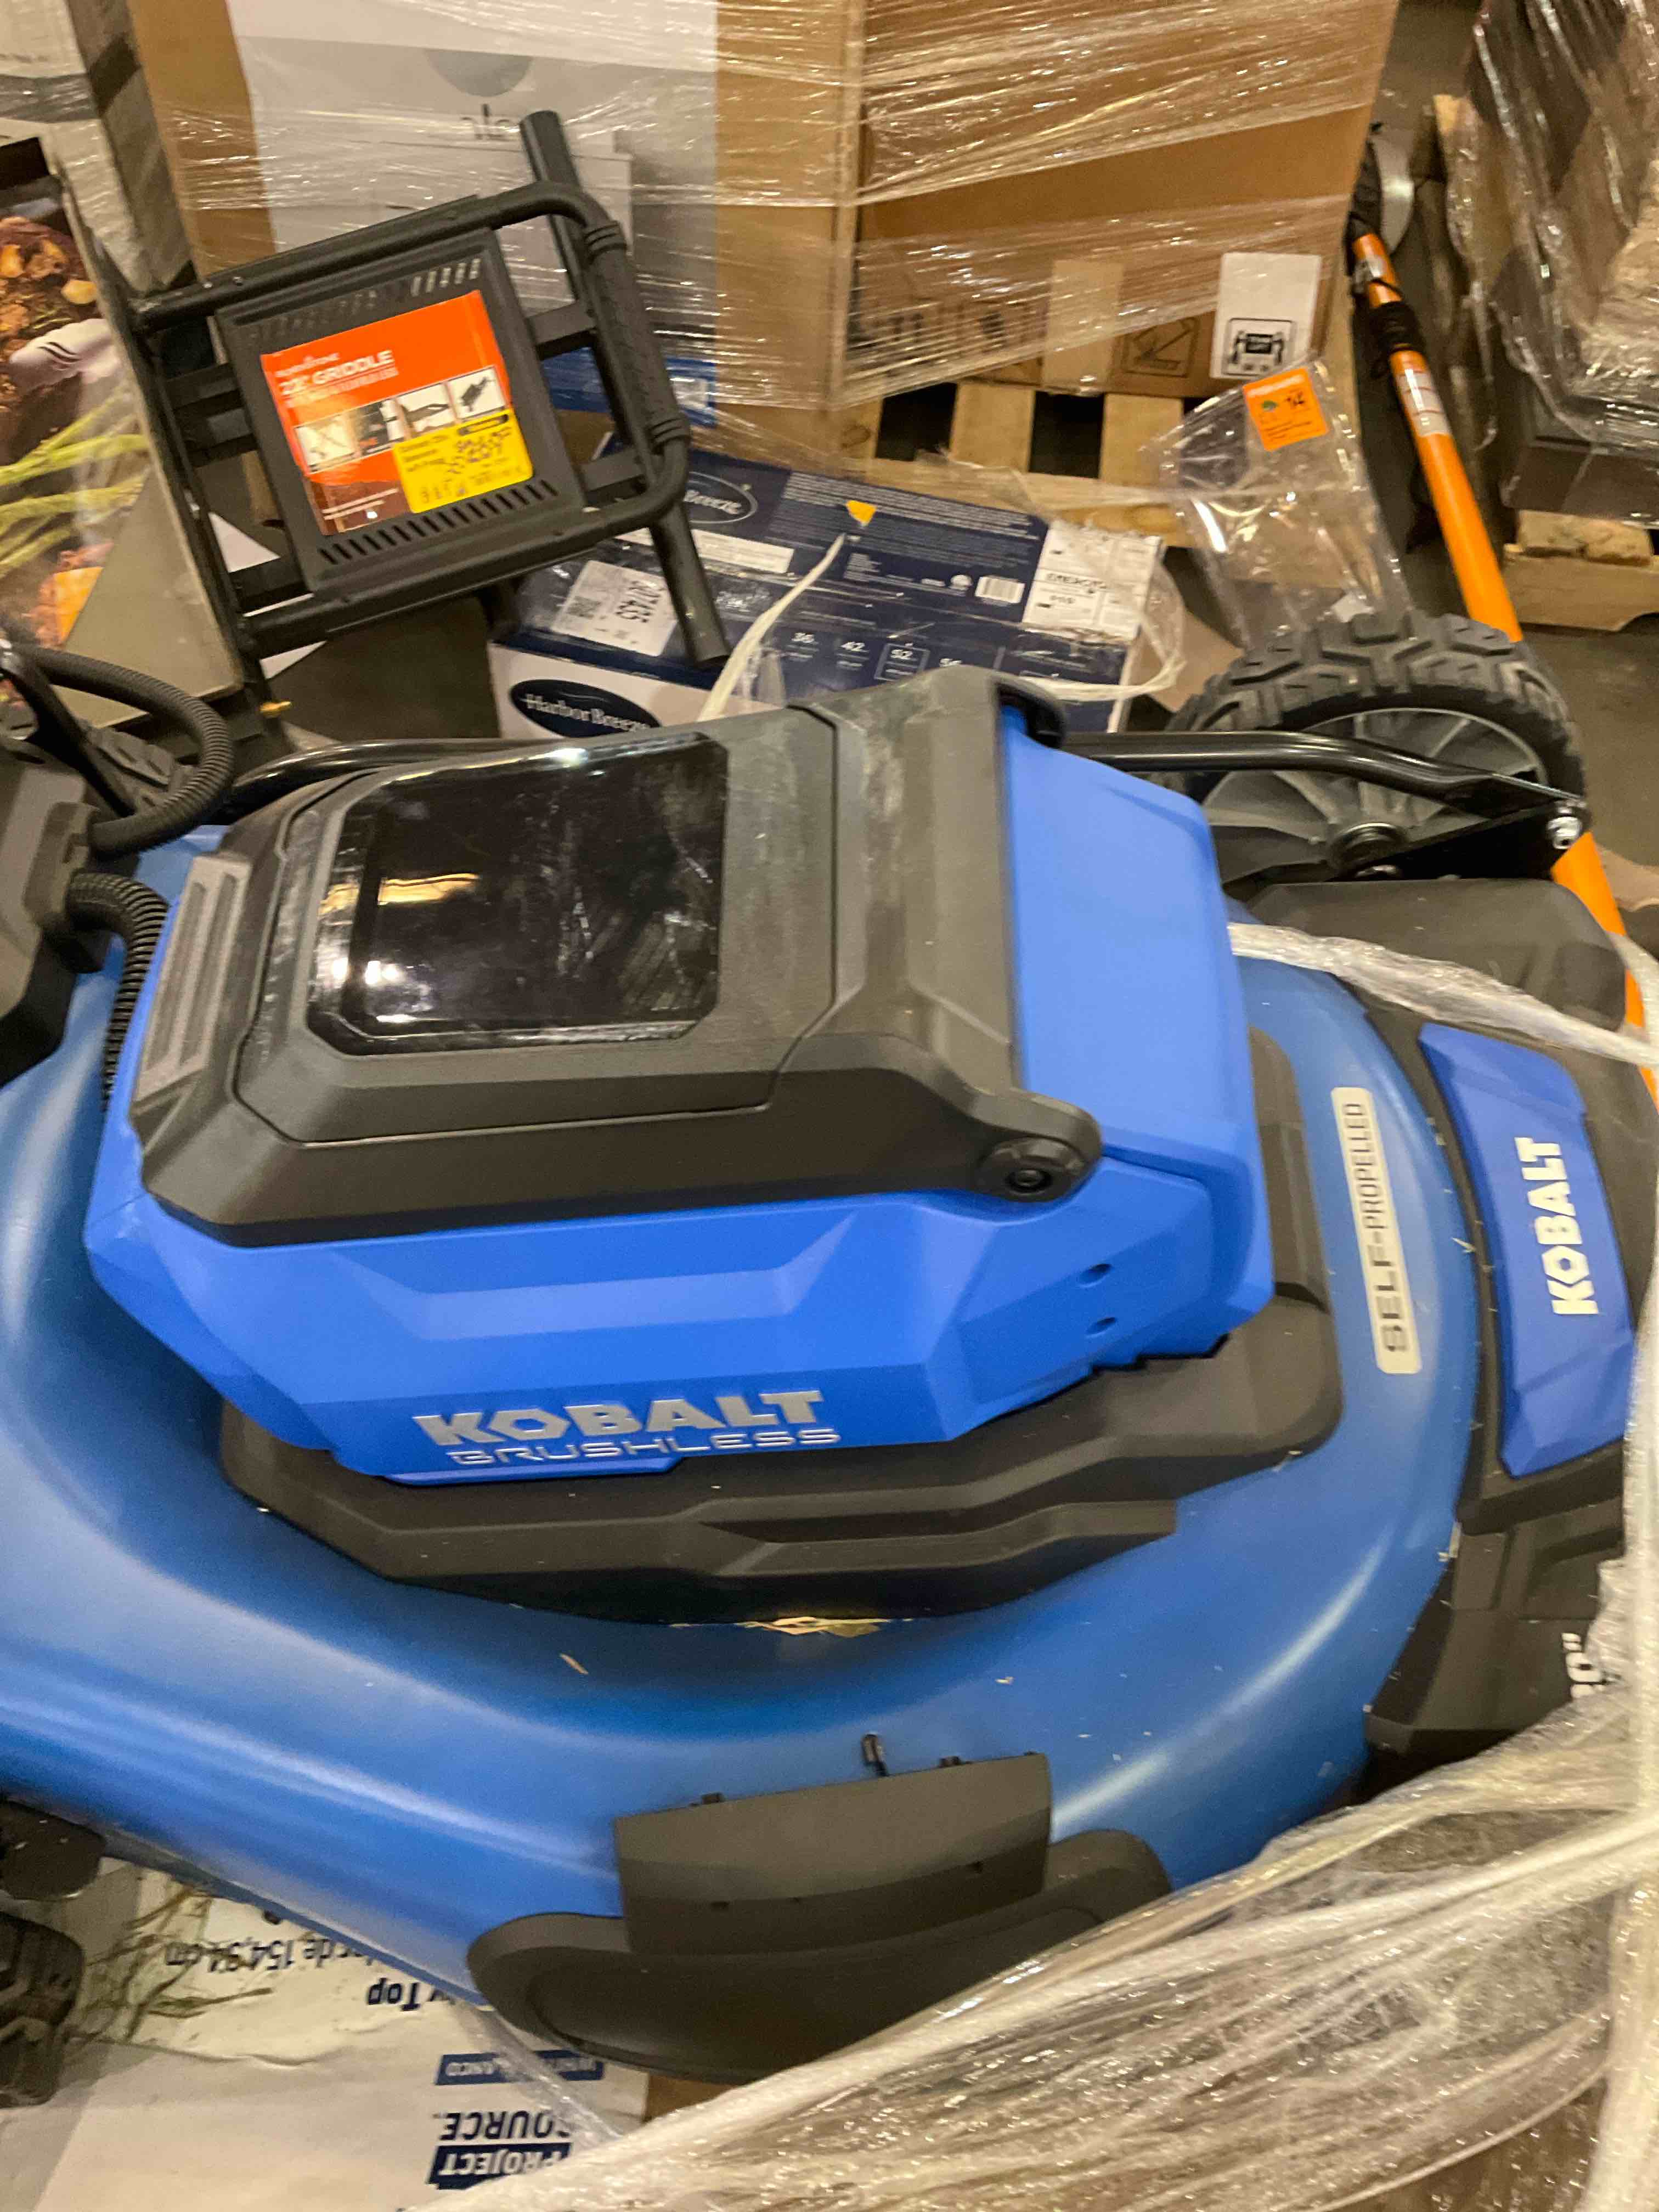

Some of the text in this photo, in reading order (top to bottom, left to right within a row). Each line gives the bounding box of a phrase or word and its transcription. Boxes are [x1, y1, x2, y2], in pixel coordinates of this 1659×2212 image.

[312, 349, 394, 385] GRIDDLE
[840, 641, 865, 651] 42
[524, 693, 590, 721] Harbor
[1342, 1103, 1409, 1352] SELF-PROPELLED
[1514, 1137, 1599, 1315] KOBALT
[413, 1390, 825, 1446] KOBALT
[445, 1428, 842, 1466] BRUSHLESS
[368, 1977, 421, 2012] Top
[438, 2110, 571, 2141] OURCE
[439, 2149, 562, 2176] PROJECT
